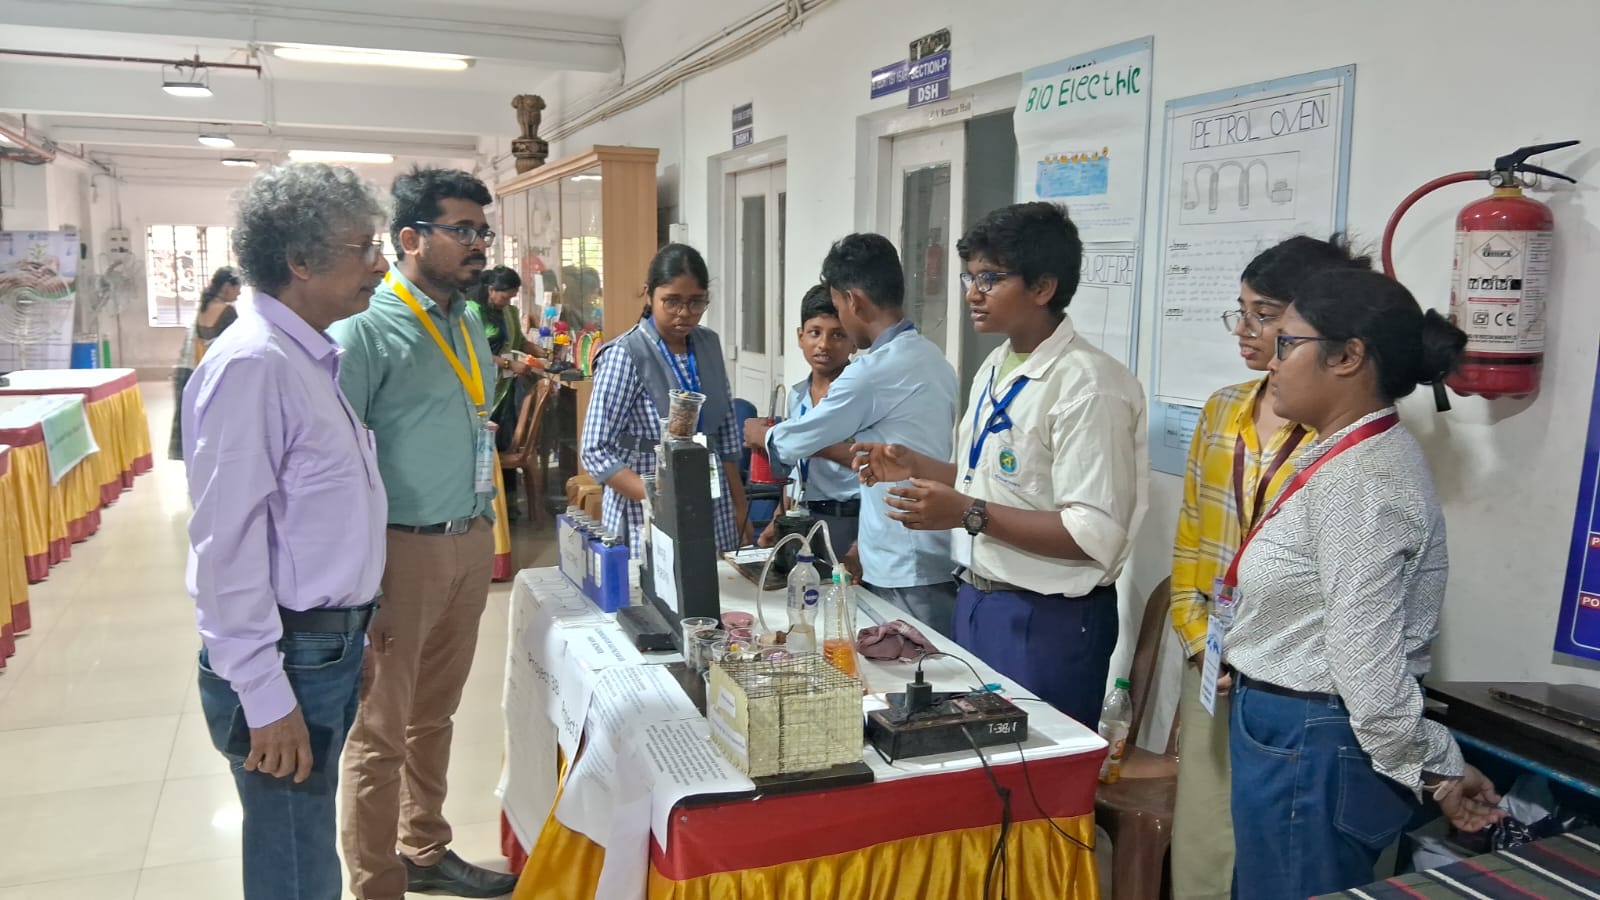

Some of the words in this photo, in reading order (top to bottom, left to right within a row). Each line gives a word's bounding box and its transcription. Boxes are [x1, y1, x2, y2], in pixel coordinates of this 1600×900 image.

[917, 83, 939, 102] DSH
[1025, 84, 1054, 112] BIO
[1194, 114, 1260, 149] PETROL
[1270, 99, 1325, 136] OVEN
